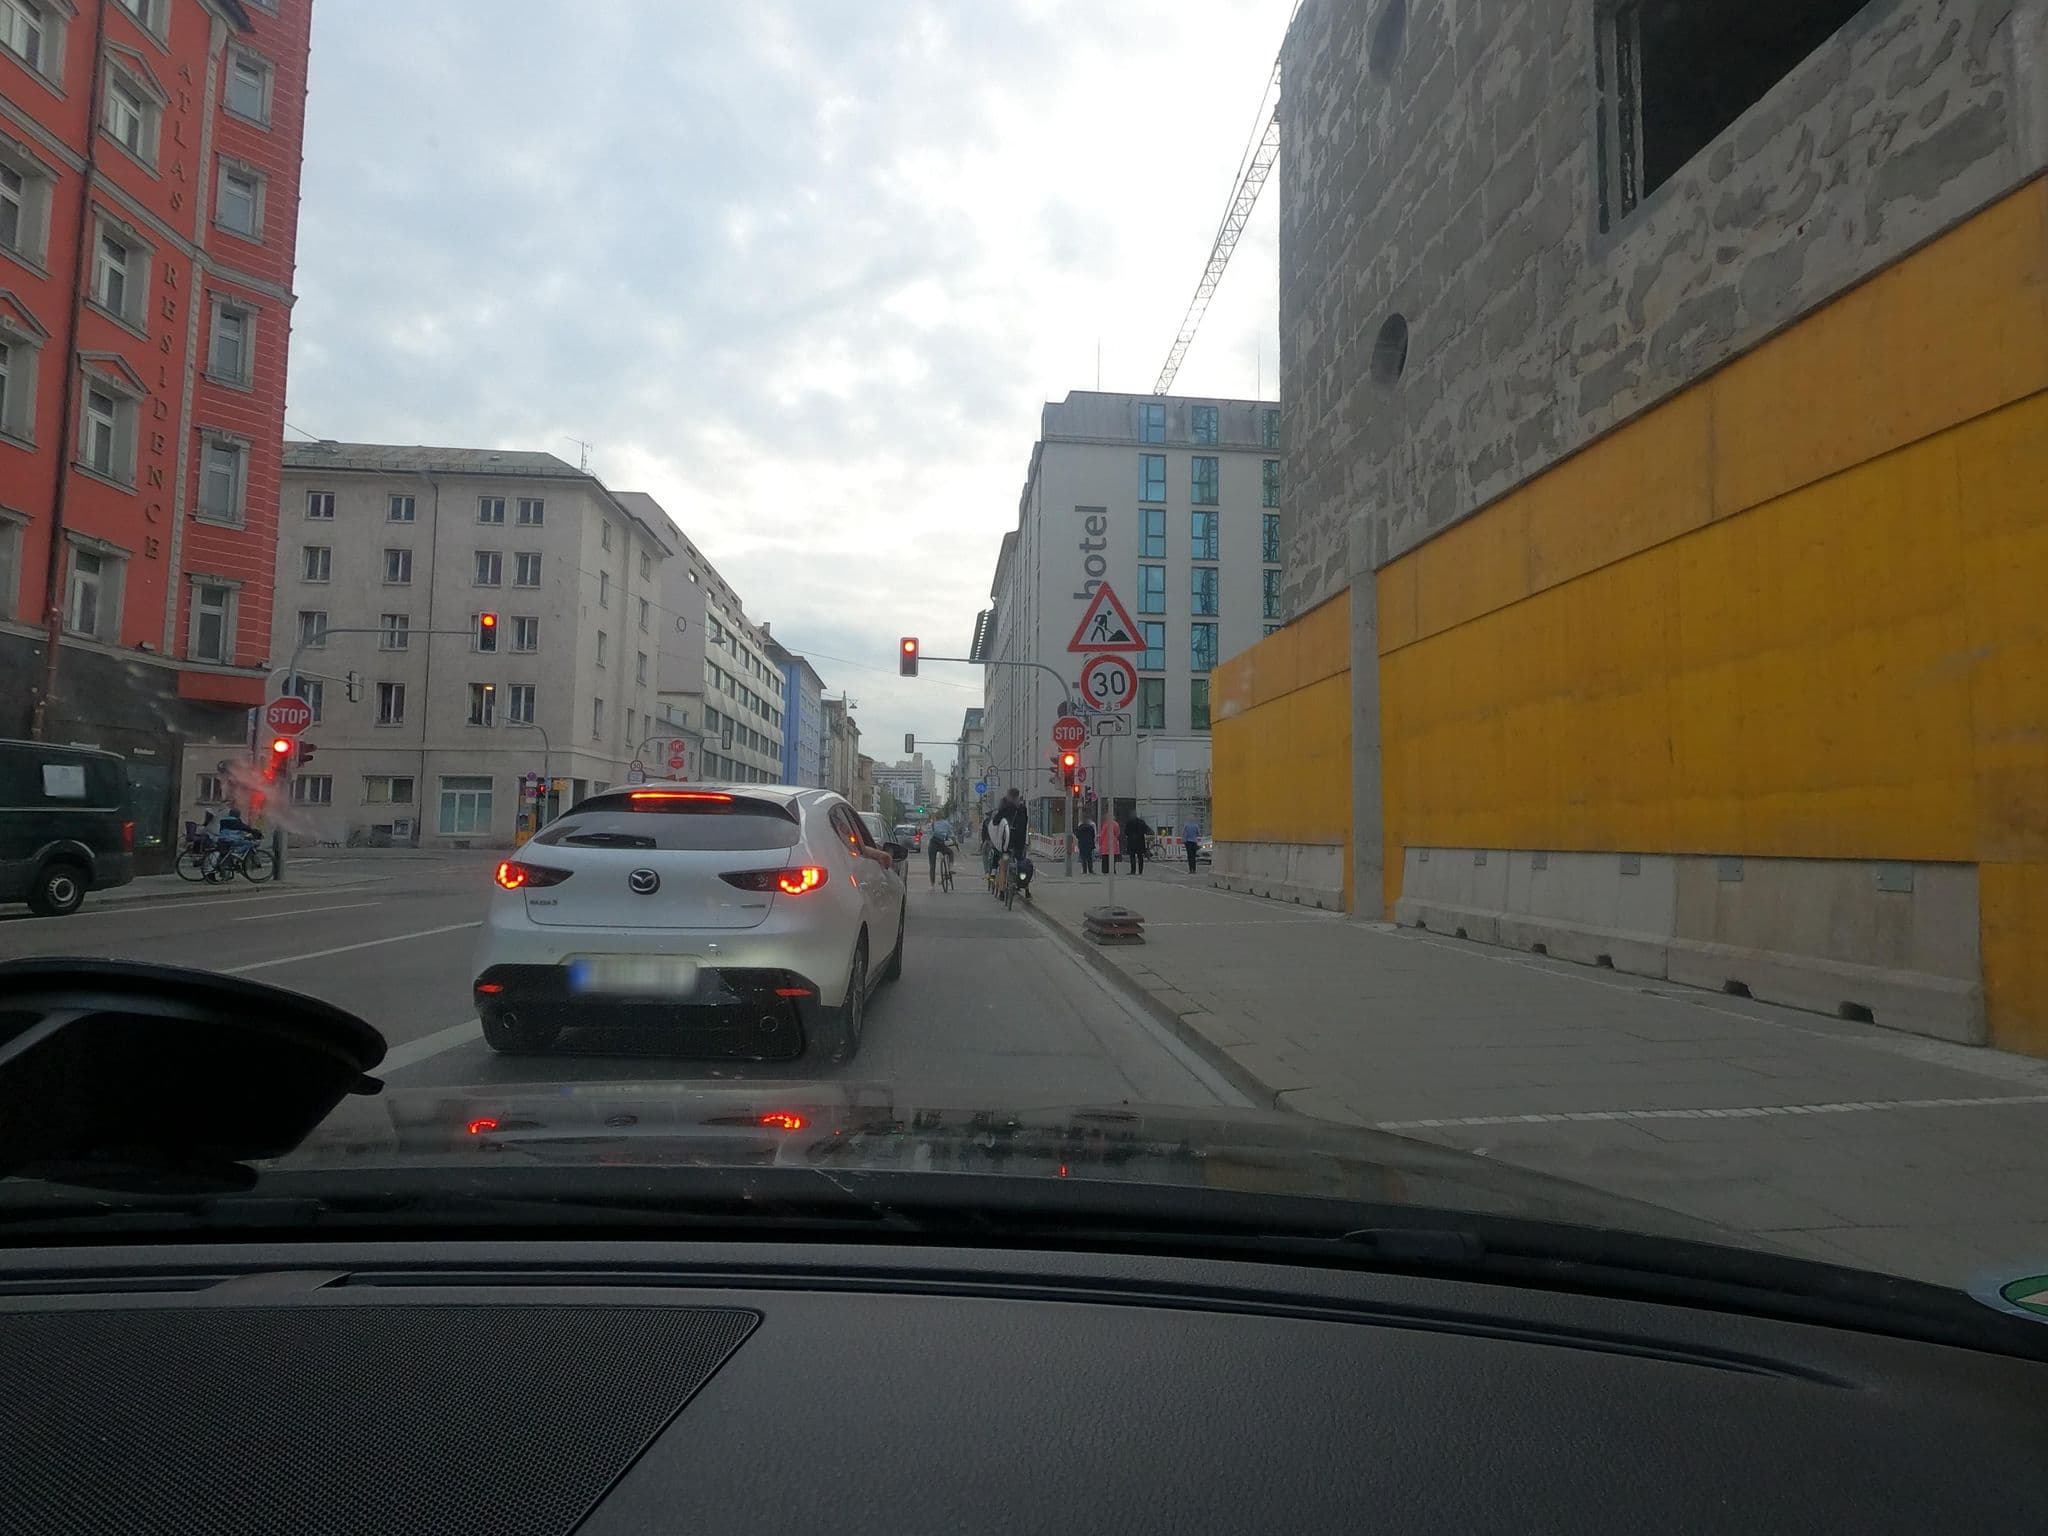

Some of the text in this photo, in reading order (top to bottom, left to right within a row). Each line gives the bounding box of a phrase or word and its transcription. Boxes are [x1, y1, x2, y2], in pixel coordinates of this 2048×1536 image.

[170, 63, 193, 210] ATLAS
[144, 261, 177, 561] RESIDENCE
[1073, 504, 1108, 600] hotel
[1092, 670, 1126, 697] 30
[268, 707, 309, 725] STOP
[1054, 726, 1084, 741] STOP
